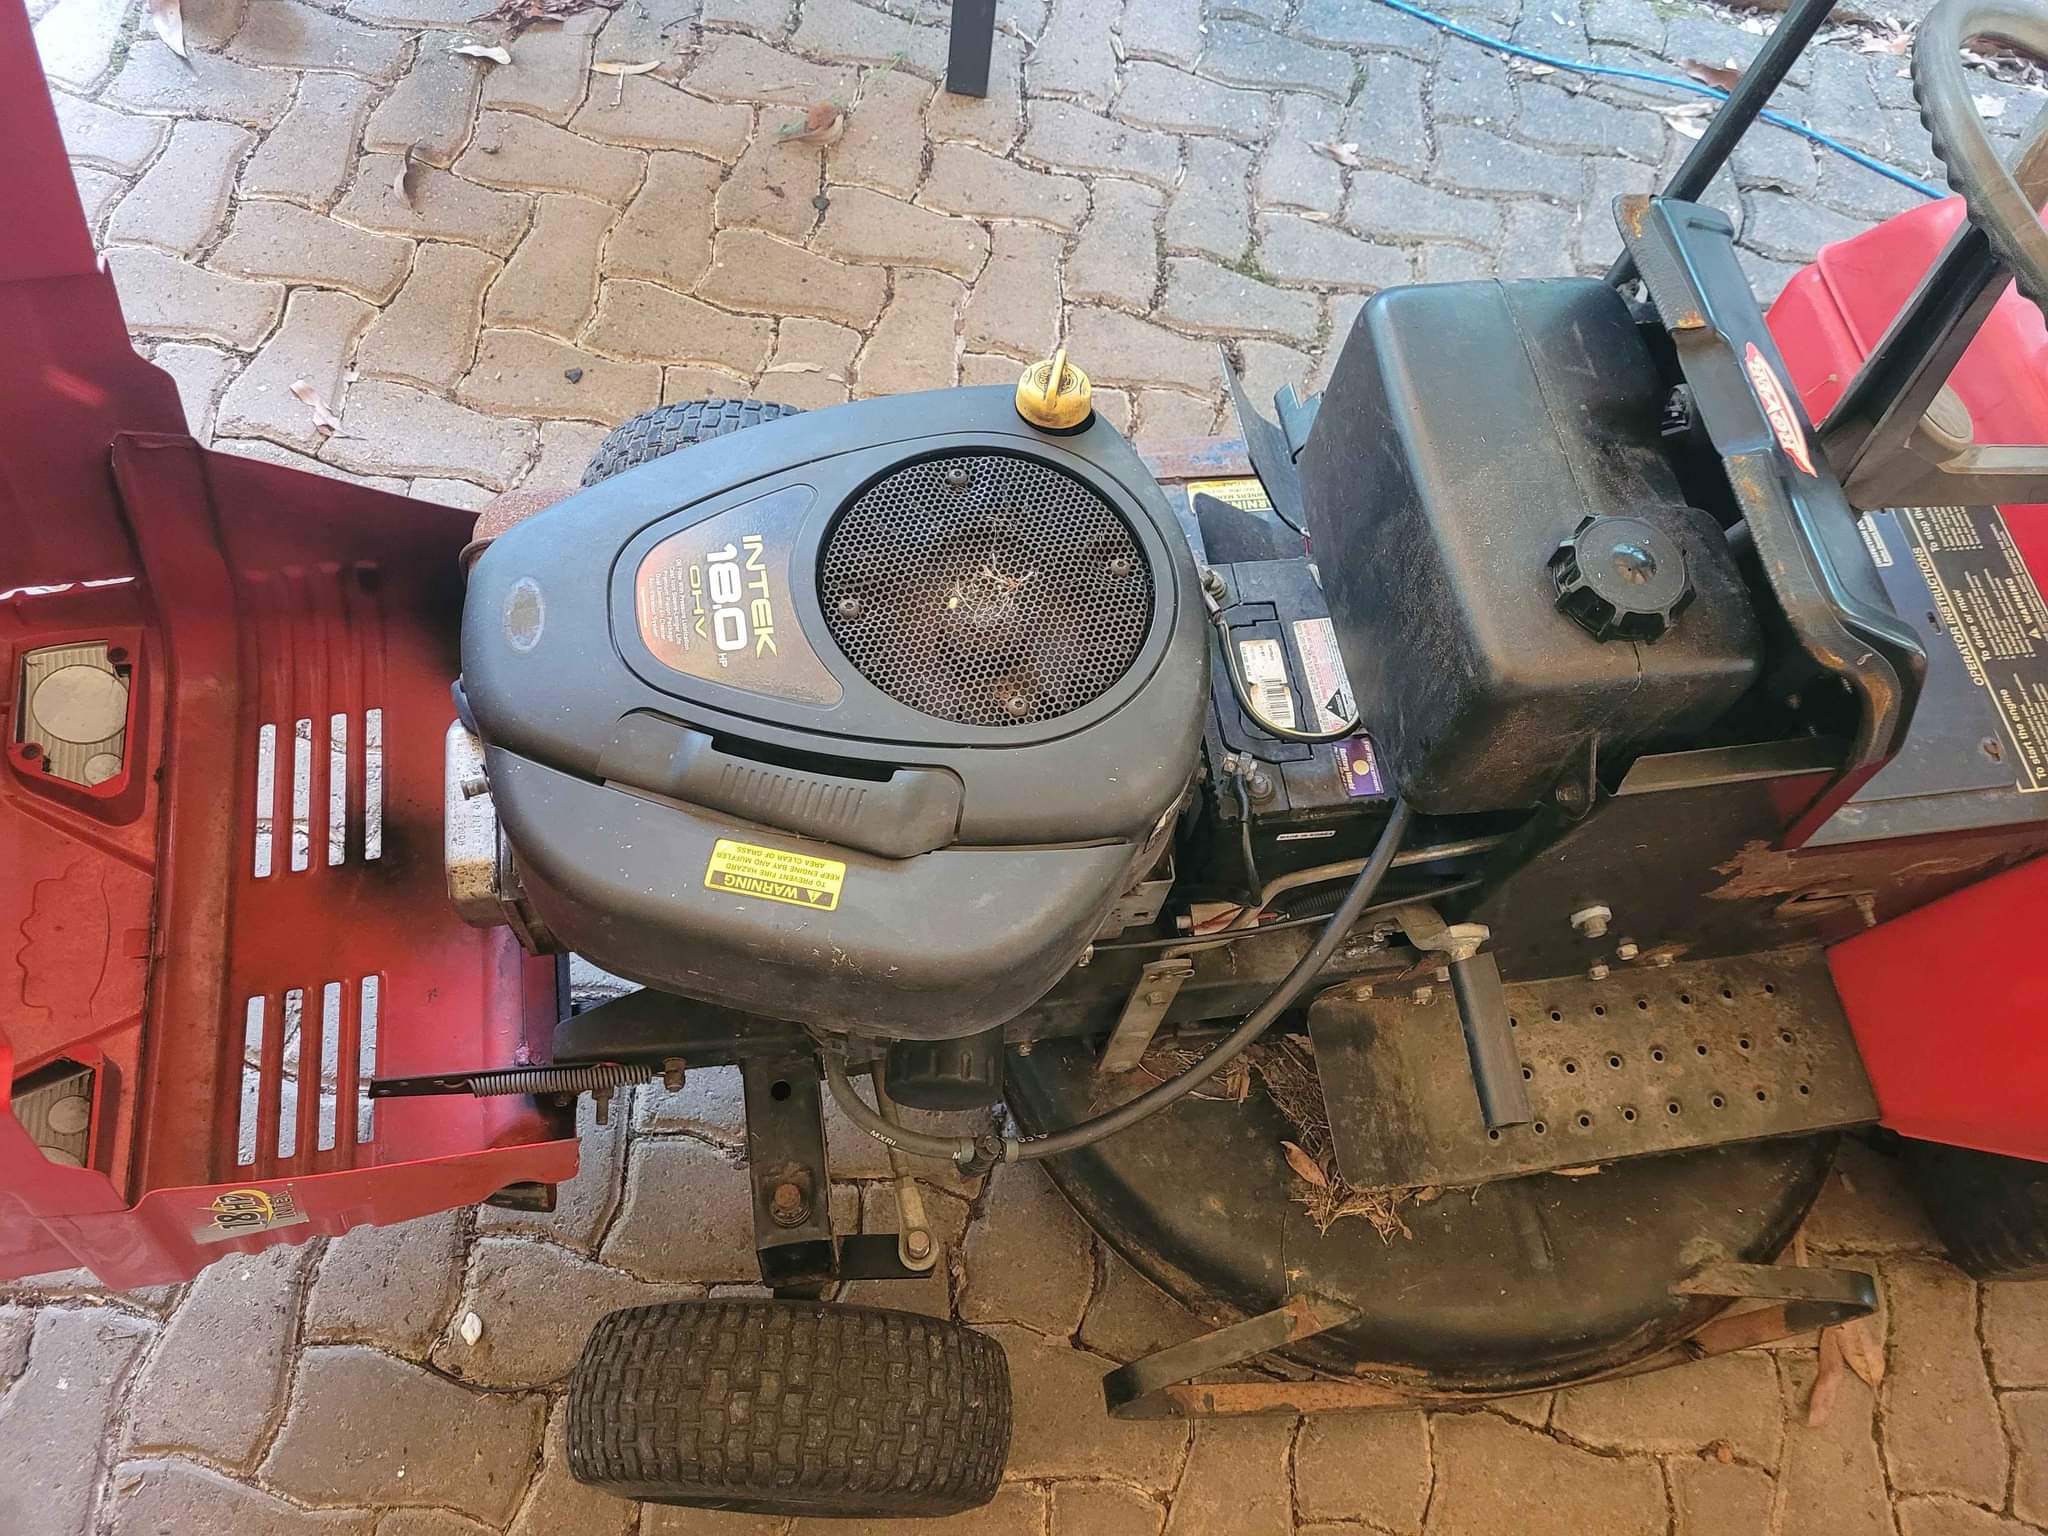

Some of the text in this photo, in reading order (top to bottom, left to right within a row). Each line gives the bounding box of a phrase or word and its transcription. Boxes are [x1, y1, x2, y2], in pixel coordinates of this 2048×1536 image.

[1917, 518, 1936, 542] stop
[1927, 539, 1941, 554] To
[742, 534, 778, 660] INTEK
[1910, 544, 1957, 626] INSTRUCTIONS
[689, 564, 708, 640] OHV
[706, 543, 748, 668] 18.0 HP
[1950, 586, 1969, 613] mow
[2003, 575, 2034, 626] WARNING
[1962, 611, 1974, 625] or
[1966, 623, 1987, 651] drive
[1948, 623, 1987, 688] OPERATOR
[1979, 648, 1992, 663] To
[1996, 686, 2022, 723] engine
[2021, 739, 2041, 766] start
[724, 874, 799, 899] WARNING
